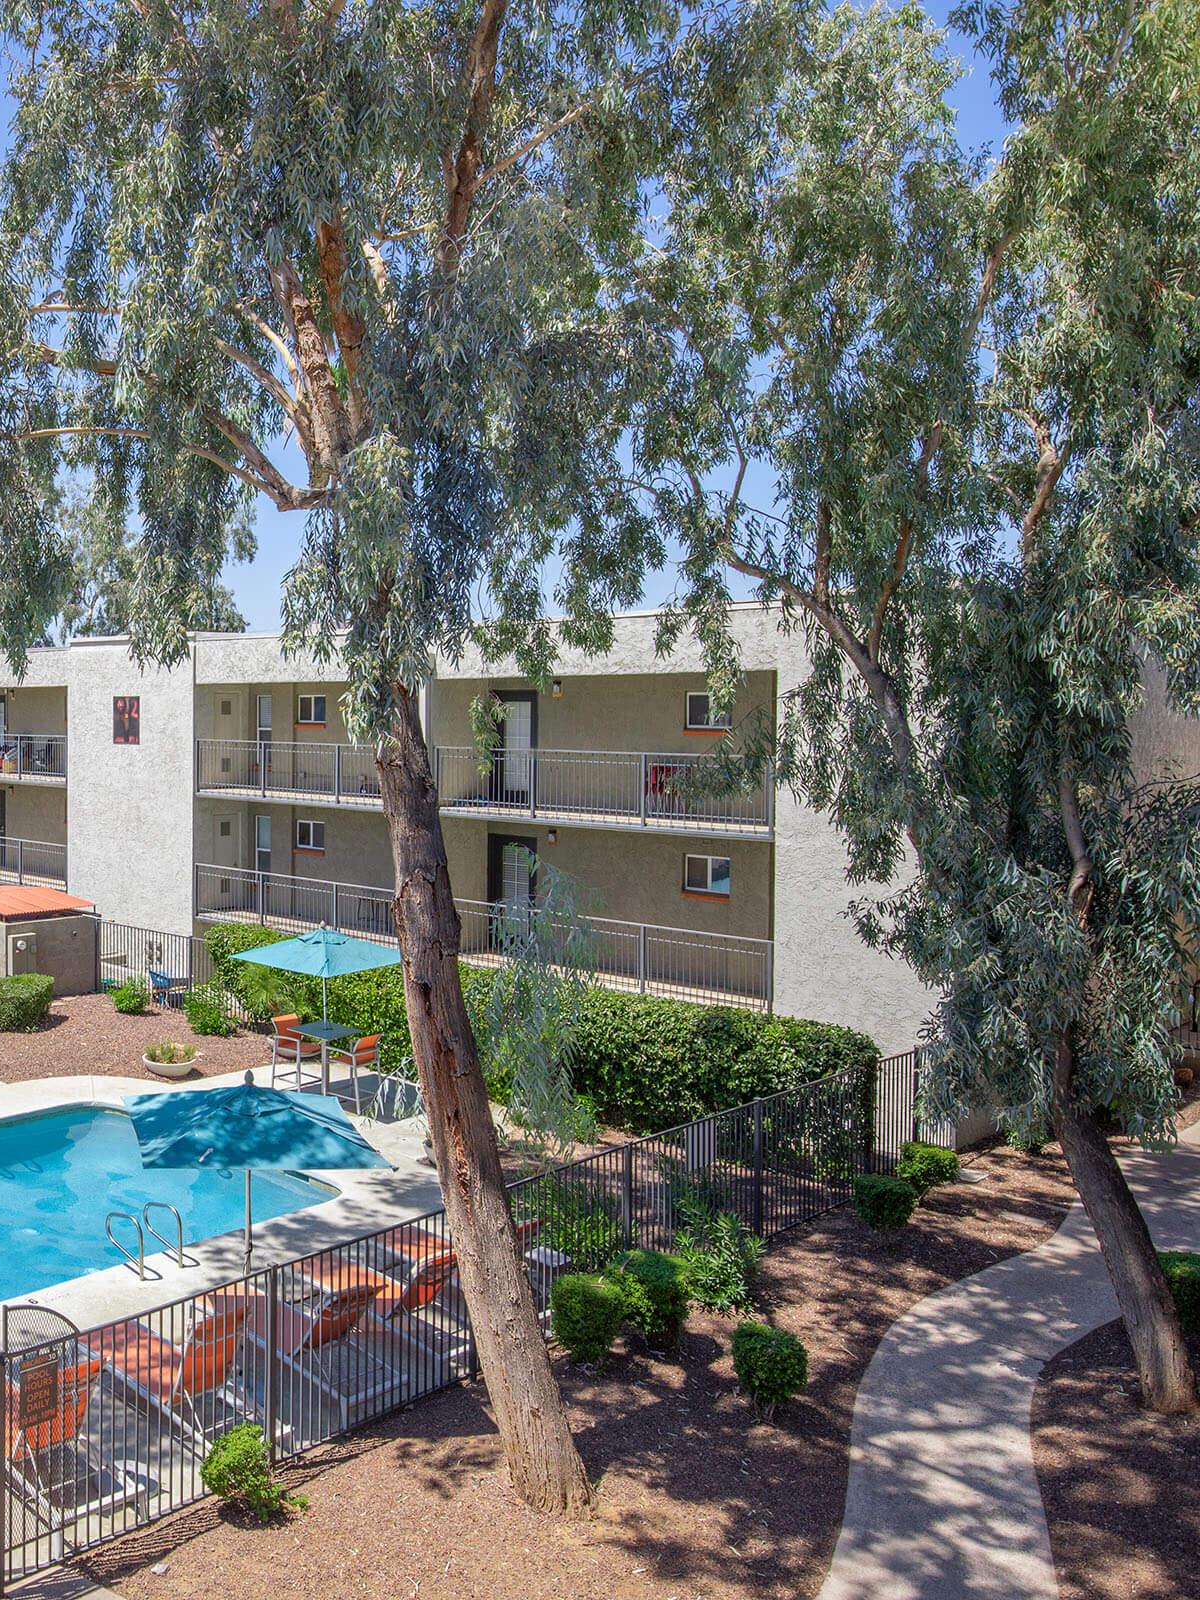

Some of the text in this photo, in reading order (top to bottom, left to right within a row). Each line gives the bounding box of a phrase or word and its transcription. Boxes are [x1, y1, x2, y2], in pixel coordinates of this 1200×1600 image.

[27, 1369, 50, 1382] POOL
[24, 1376, 54, 1393] HOURS
[26, 1388, 50, 1403] OPEN
[26, 1398, 50, 1413] DAILY
